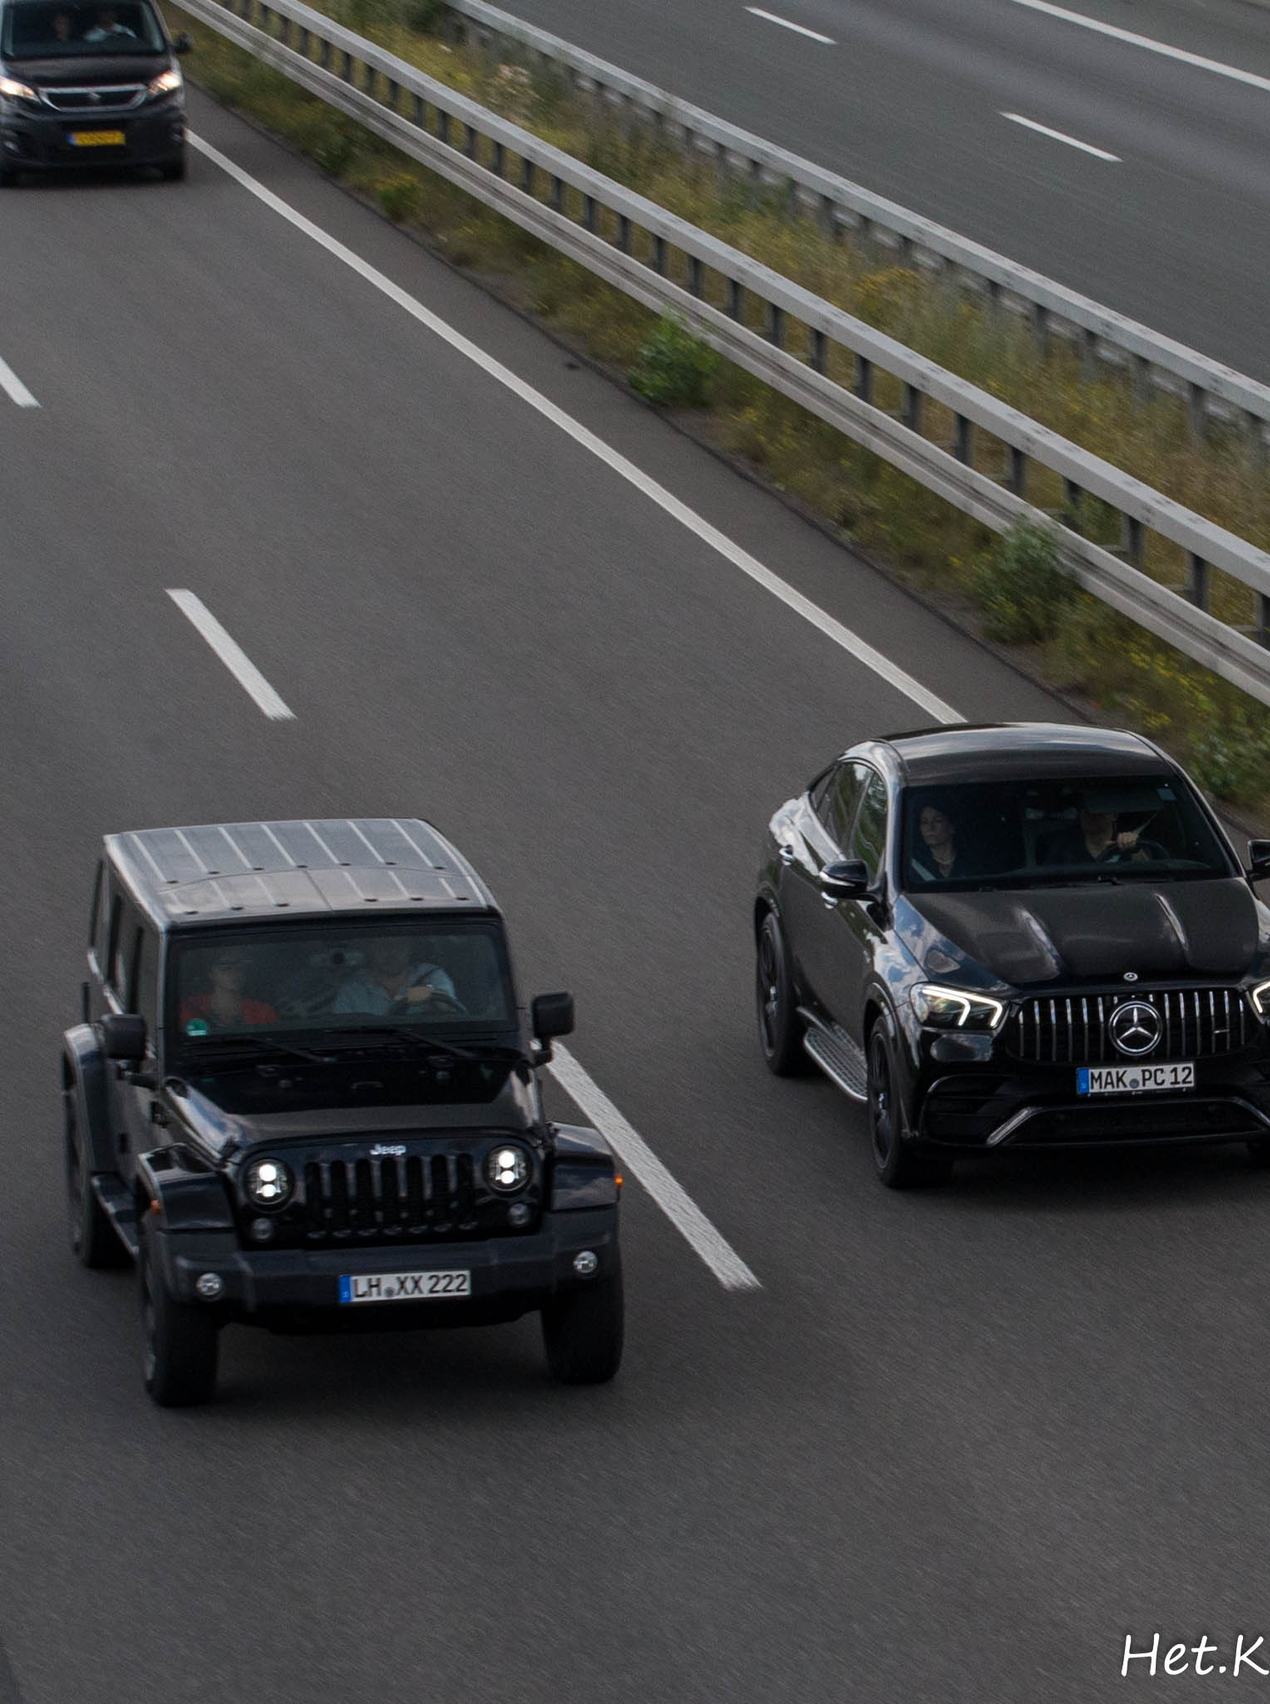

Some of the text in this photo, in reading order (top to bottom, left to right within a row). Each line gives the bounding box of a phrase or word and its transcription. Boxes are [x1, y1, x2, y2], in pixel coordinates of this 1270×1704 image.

[1090, 1066, 1193, 1090] MAK PC 12
[370, 1144, 406, 1156] Jeep
[353, 1274, 468, 1298] LH XX 222
